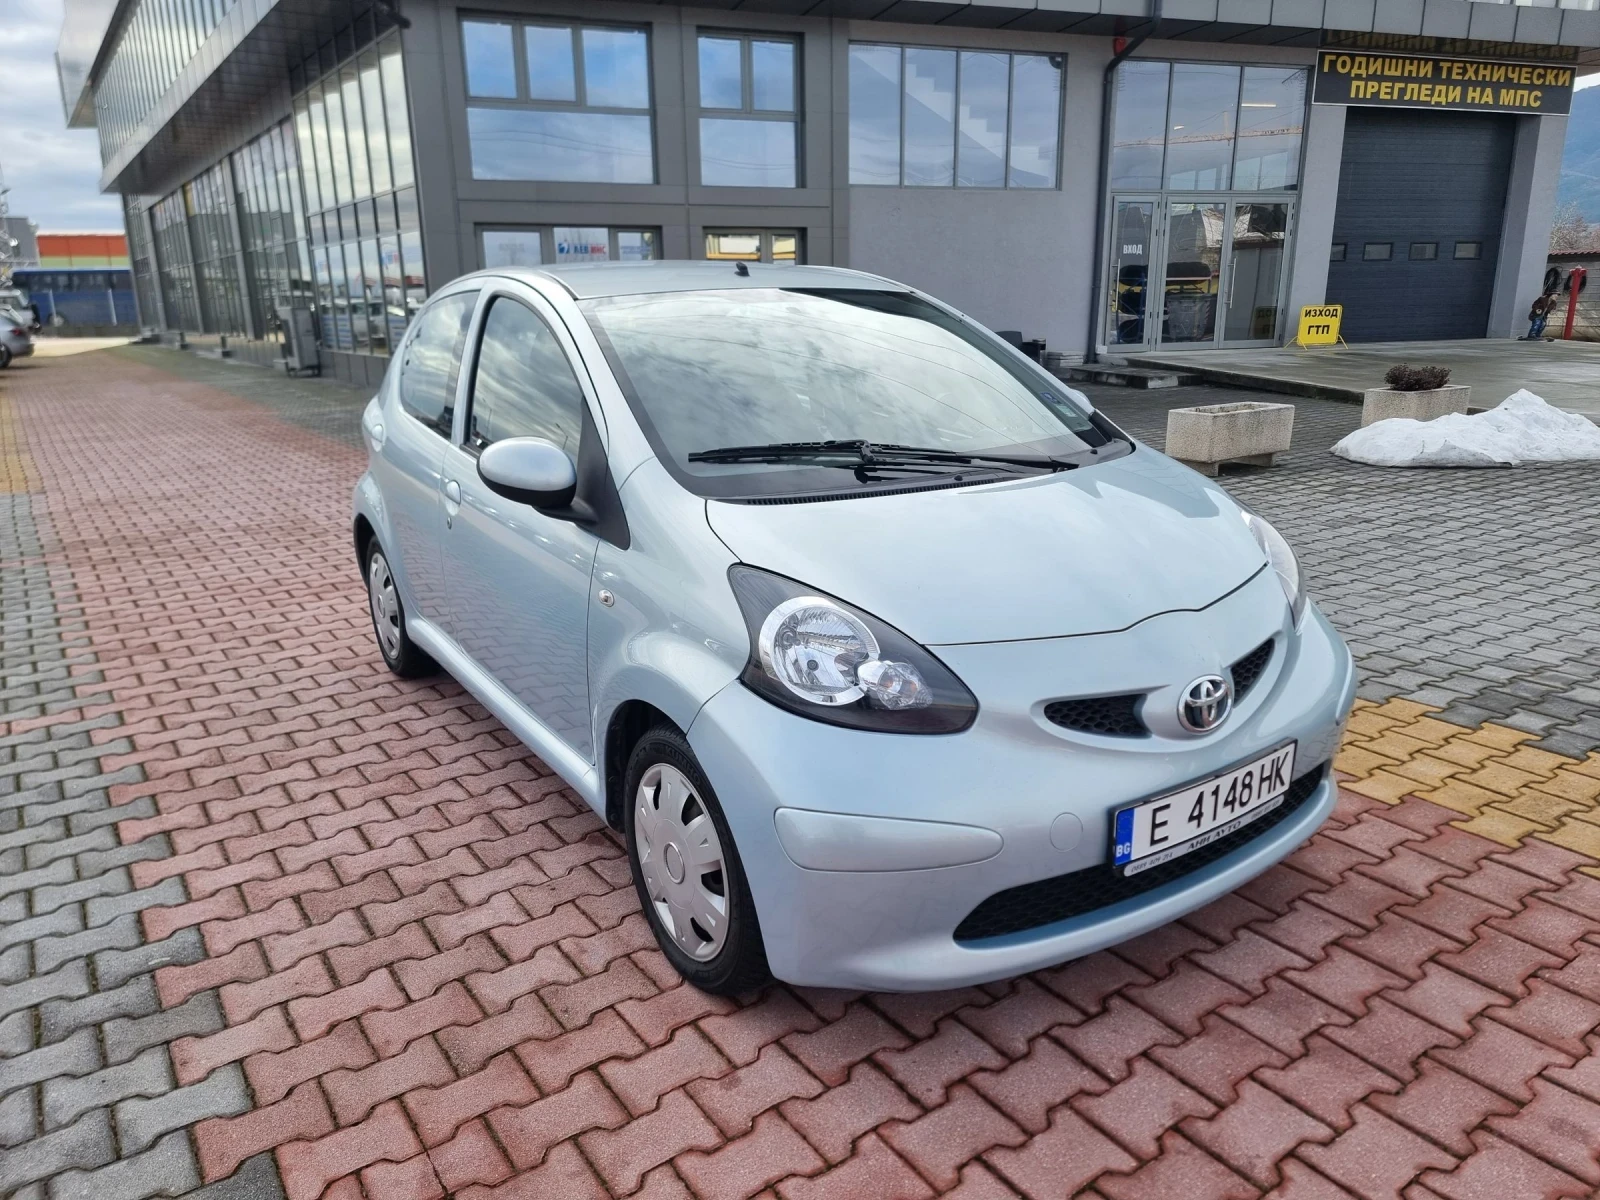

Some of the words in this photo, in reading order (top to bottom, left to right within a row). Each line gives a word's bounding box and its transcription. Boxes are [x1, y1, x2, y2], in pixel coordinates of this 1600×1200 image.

[1323, 54, 1433, 78] ГОДИШНИ
[1440, 61, 1572, 87] ТЕХНИЧЕСКИ
[1350, 80, 1462, 105] ПРЕГЛЕДИ
[1467, 87, 1494, 105] НА
[1499, 89, 1542, 108] МПС
[1123, 244, 1143, 255] ВХОД
[1304, 308, 1339, 319] ИЗХОД
[1307, 324, 1331, 335] ГТП
[1150, 803, 1171, 847] E
[1116, 842, 1131, 857] BG
